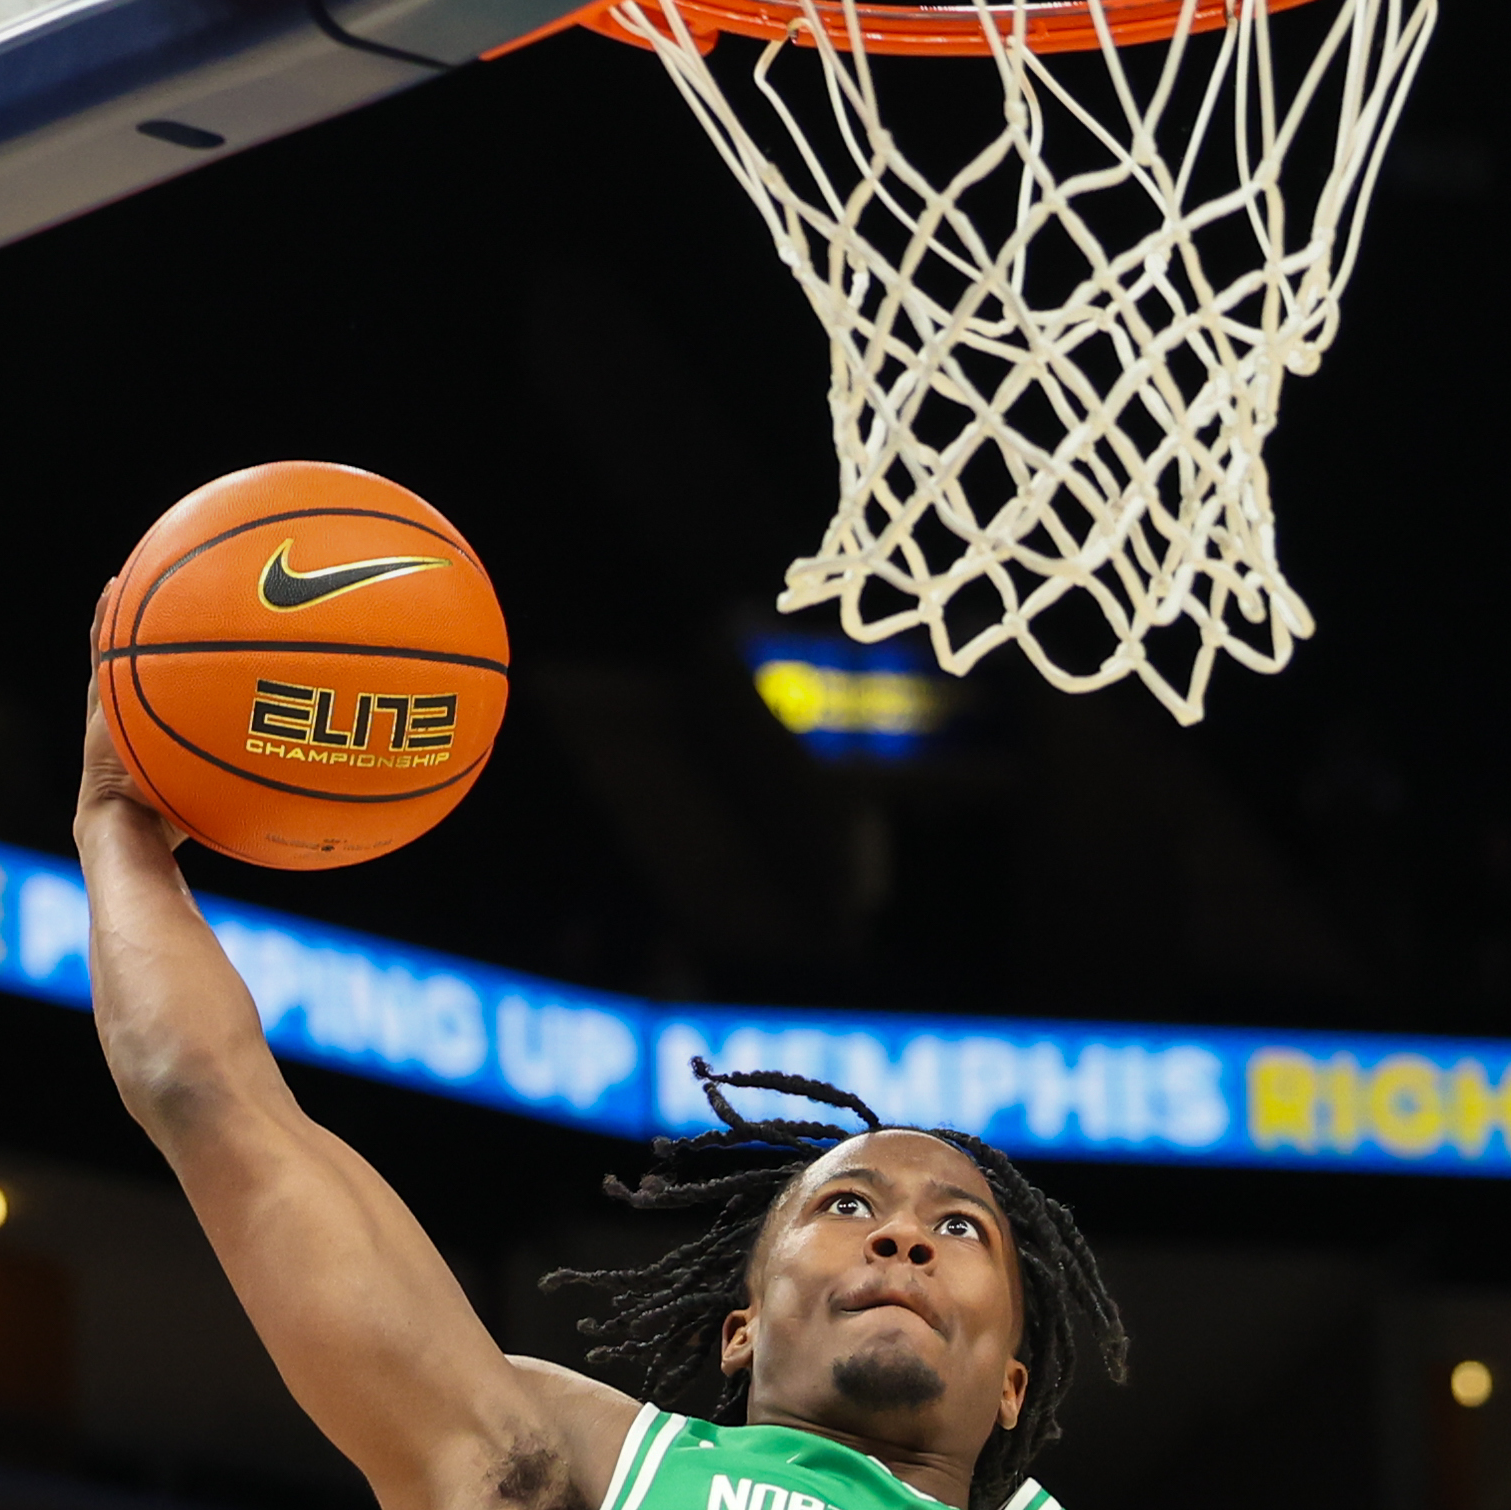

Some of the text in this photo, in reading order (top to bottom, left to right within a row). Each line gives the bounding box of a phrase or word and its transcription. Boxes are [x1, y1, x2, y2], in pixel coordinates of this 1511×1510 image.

[248, 678, 459, 752] ELITE
[245, 738, 451, 769] CHAMPIONSHIP
[18, 872, 488, 1080] PPING
[494, 995, 638, 1114] UP
[653, 1023, 1231, 1152] MEMPHIS
